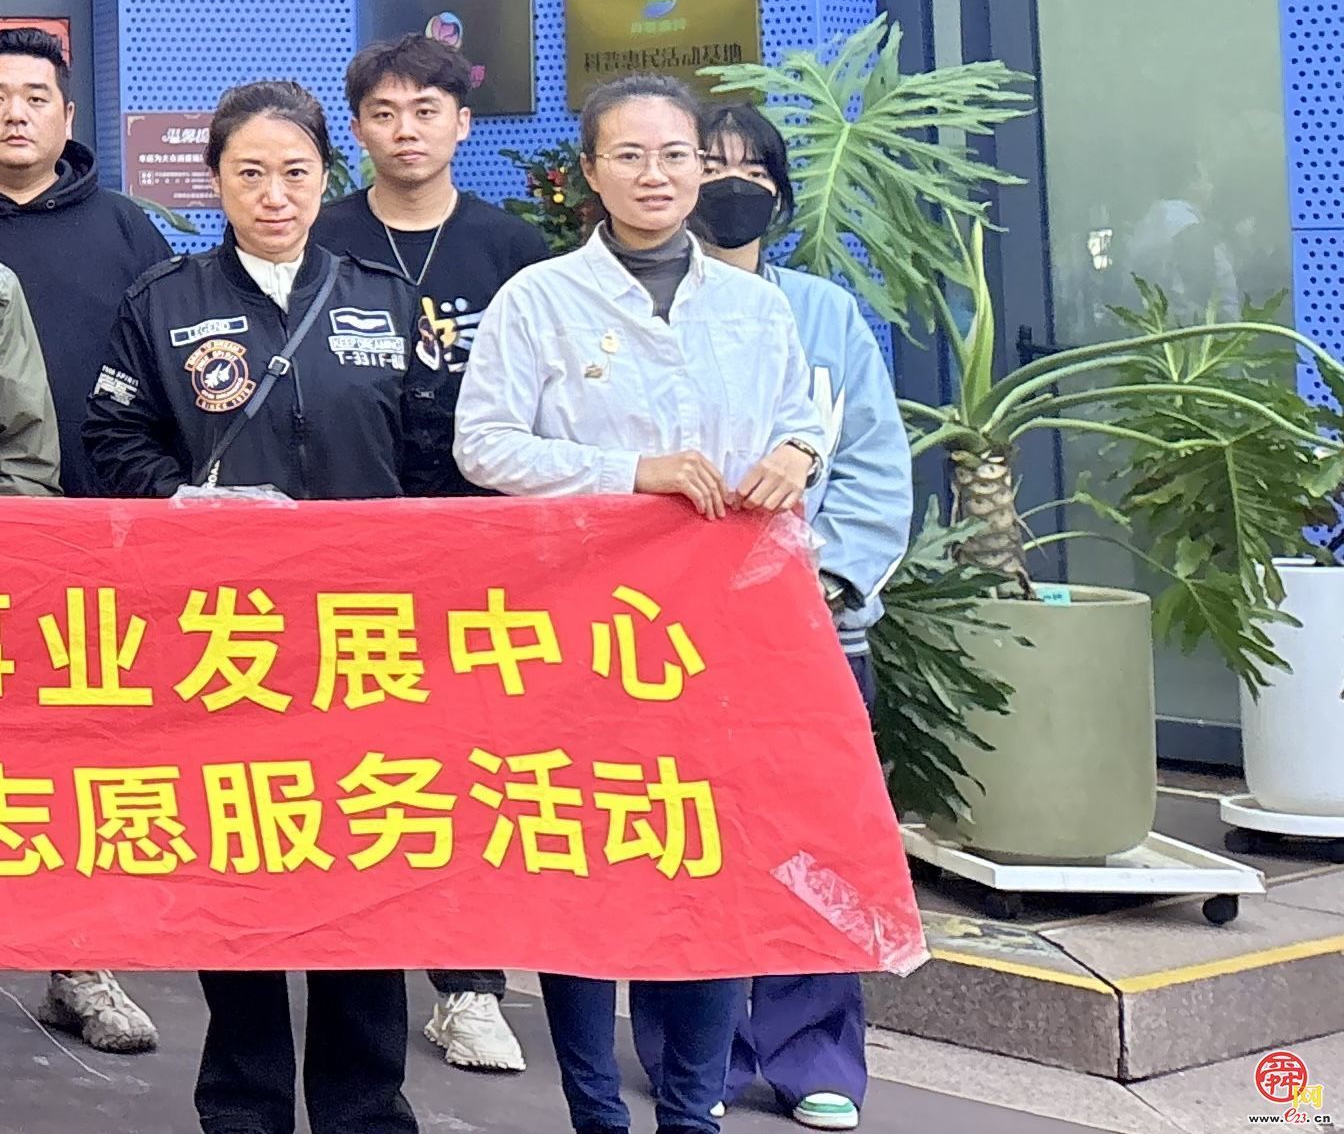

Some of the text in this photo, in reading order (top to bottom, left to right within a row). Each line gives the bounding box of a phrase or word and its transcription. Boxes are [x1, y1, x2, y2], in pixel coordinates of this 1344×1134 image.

[584, 42, 742, 73] 科普惠民活动基地
